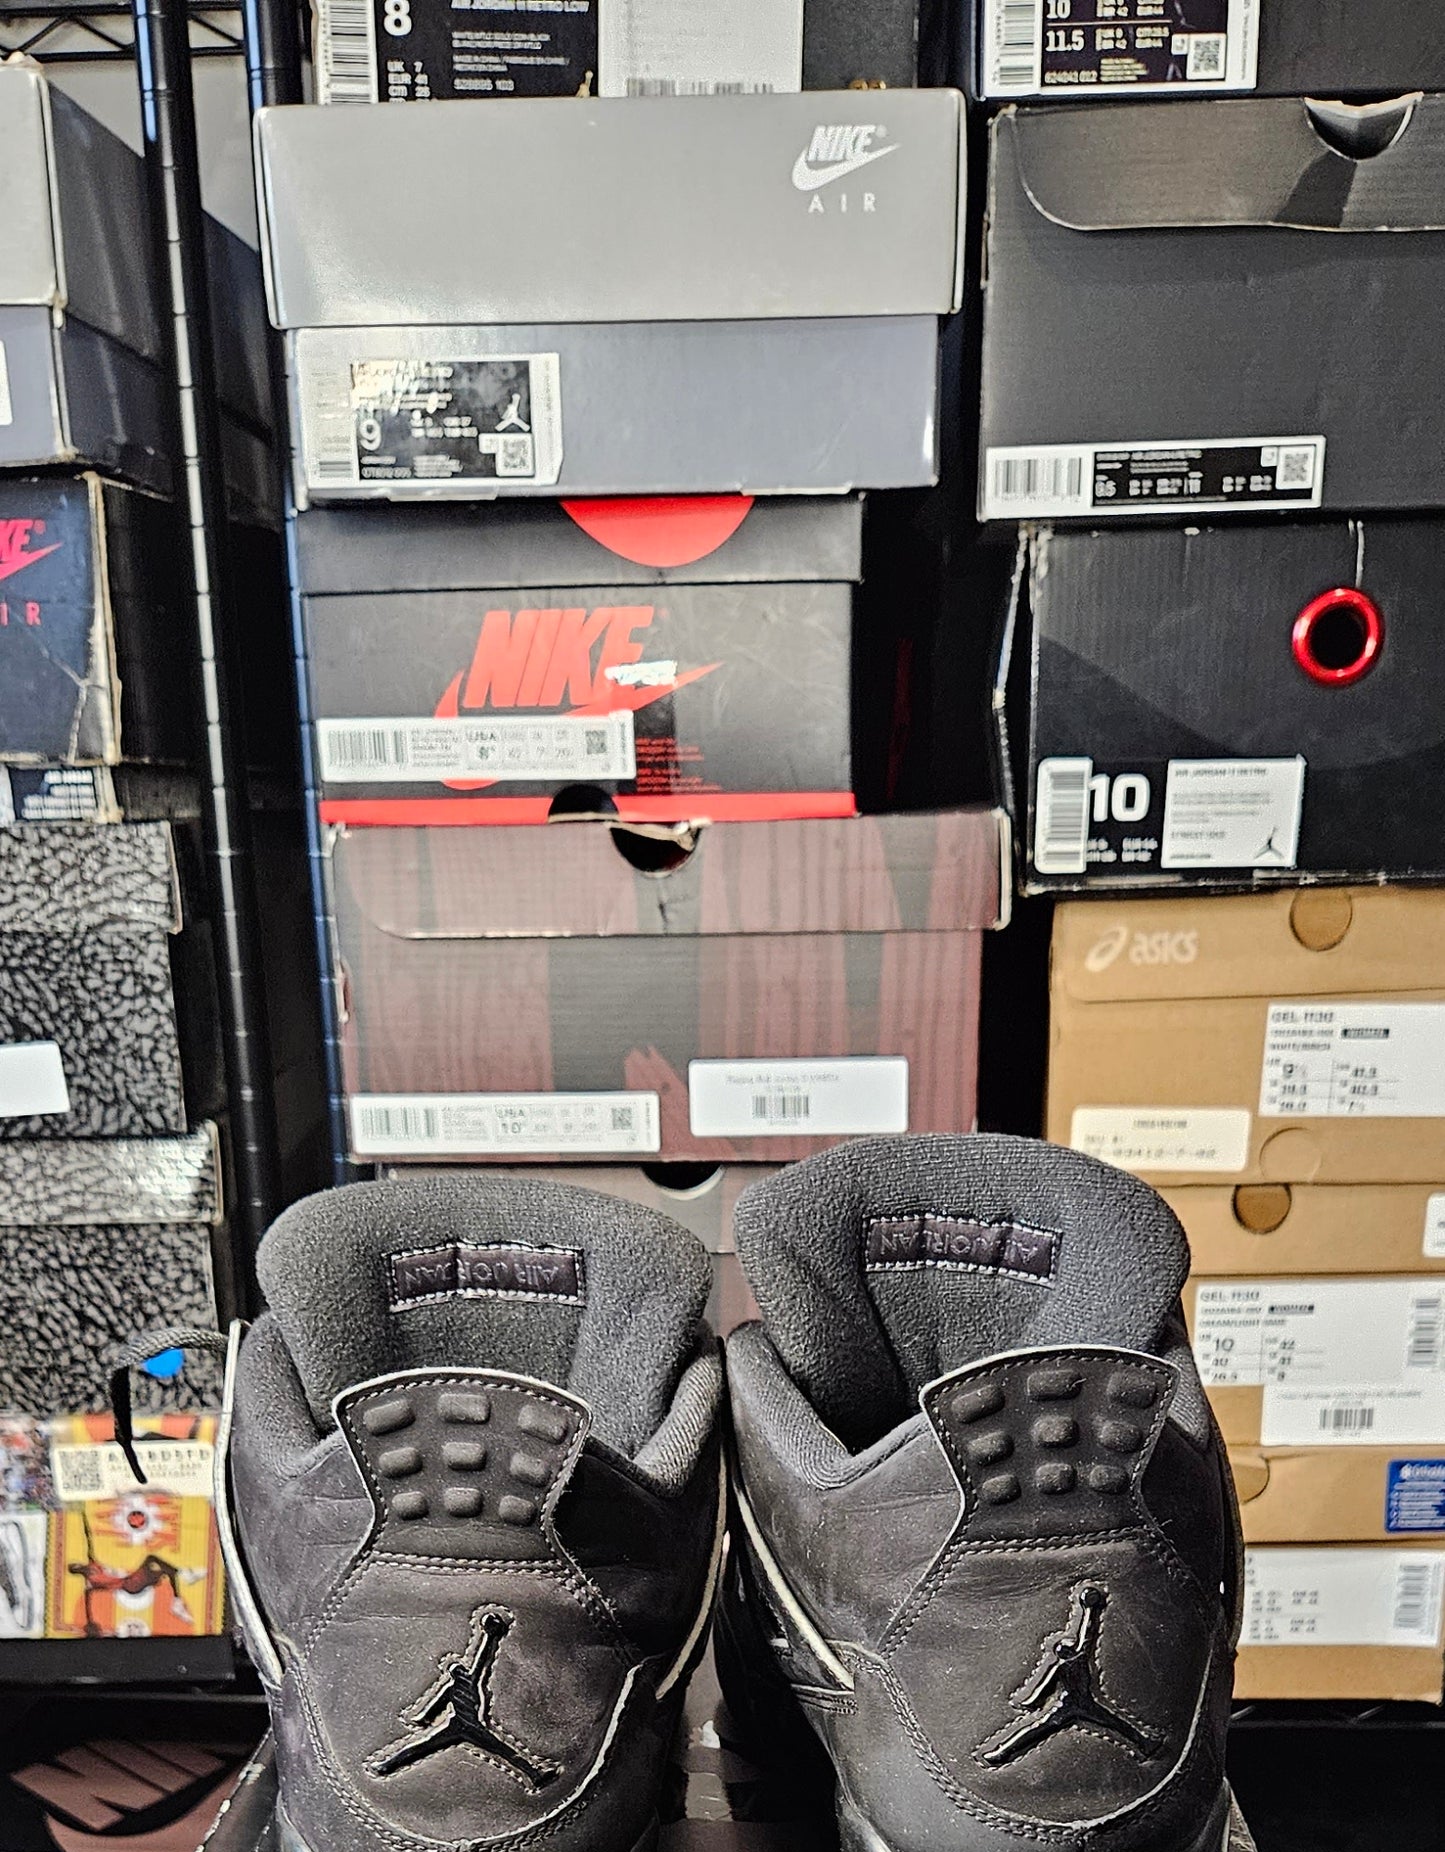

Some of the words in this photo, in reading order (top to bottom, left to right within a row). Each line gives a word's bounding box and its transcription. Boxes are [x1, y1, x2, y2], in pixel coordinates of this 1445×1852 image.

[383, 0, 412, 36] 8
[1047, 0, 1070, 19] 10
[1045, 30, 1085, 51] 11.5
[807, 124, 876, 162] NIKE
[808, 192, 876, 213] AIR
[359, 418, 382, 451] 9
[463, 605, 654, 708] NIKE
[1089, 773, 1151, 822] 10
[1129, 929, 1198, 964] asics
[514, 1263, 560, 1290] AIR
